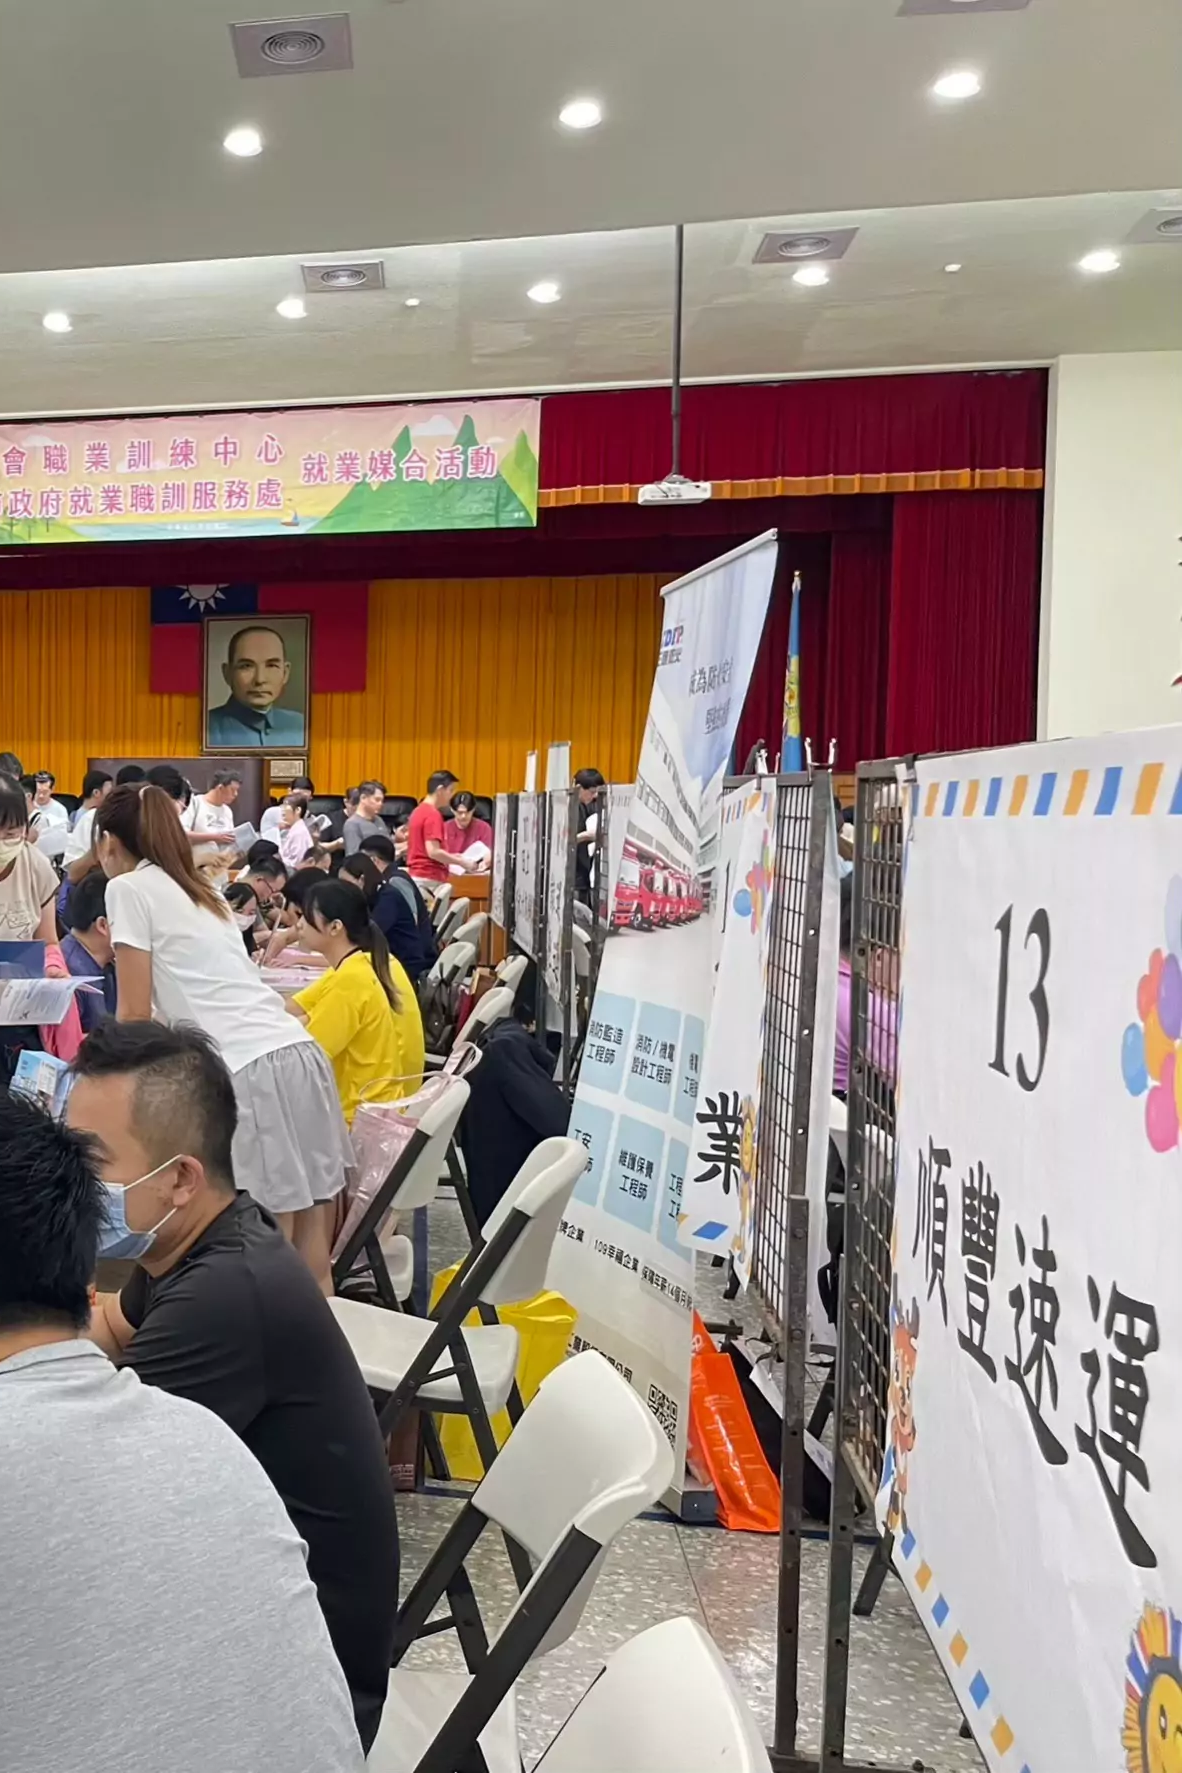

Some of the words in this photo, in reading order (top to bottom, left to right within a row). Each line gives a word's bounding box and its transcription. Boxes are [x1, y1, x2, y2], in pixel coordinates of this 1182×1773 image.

[301, 445, 497, 483] 就業媒合活動
[987, 902, 1052, 1093] 13
[586, 1042, 617, 1066] 工程師
[630, 1055, 673, 1086] 設計工程師
[618, 1173, 649, 1201] 工程師
[911, 1134, 1159, 1568] 順豐速運
